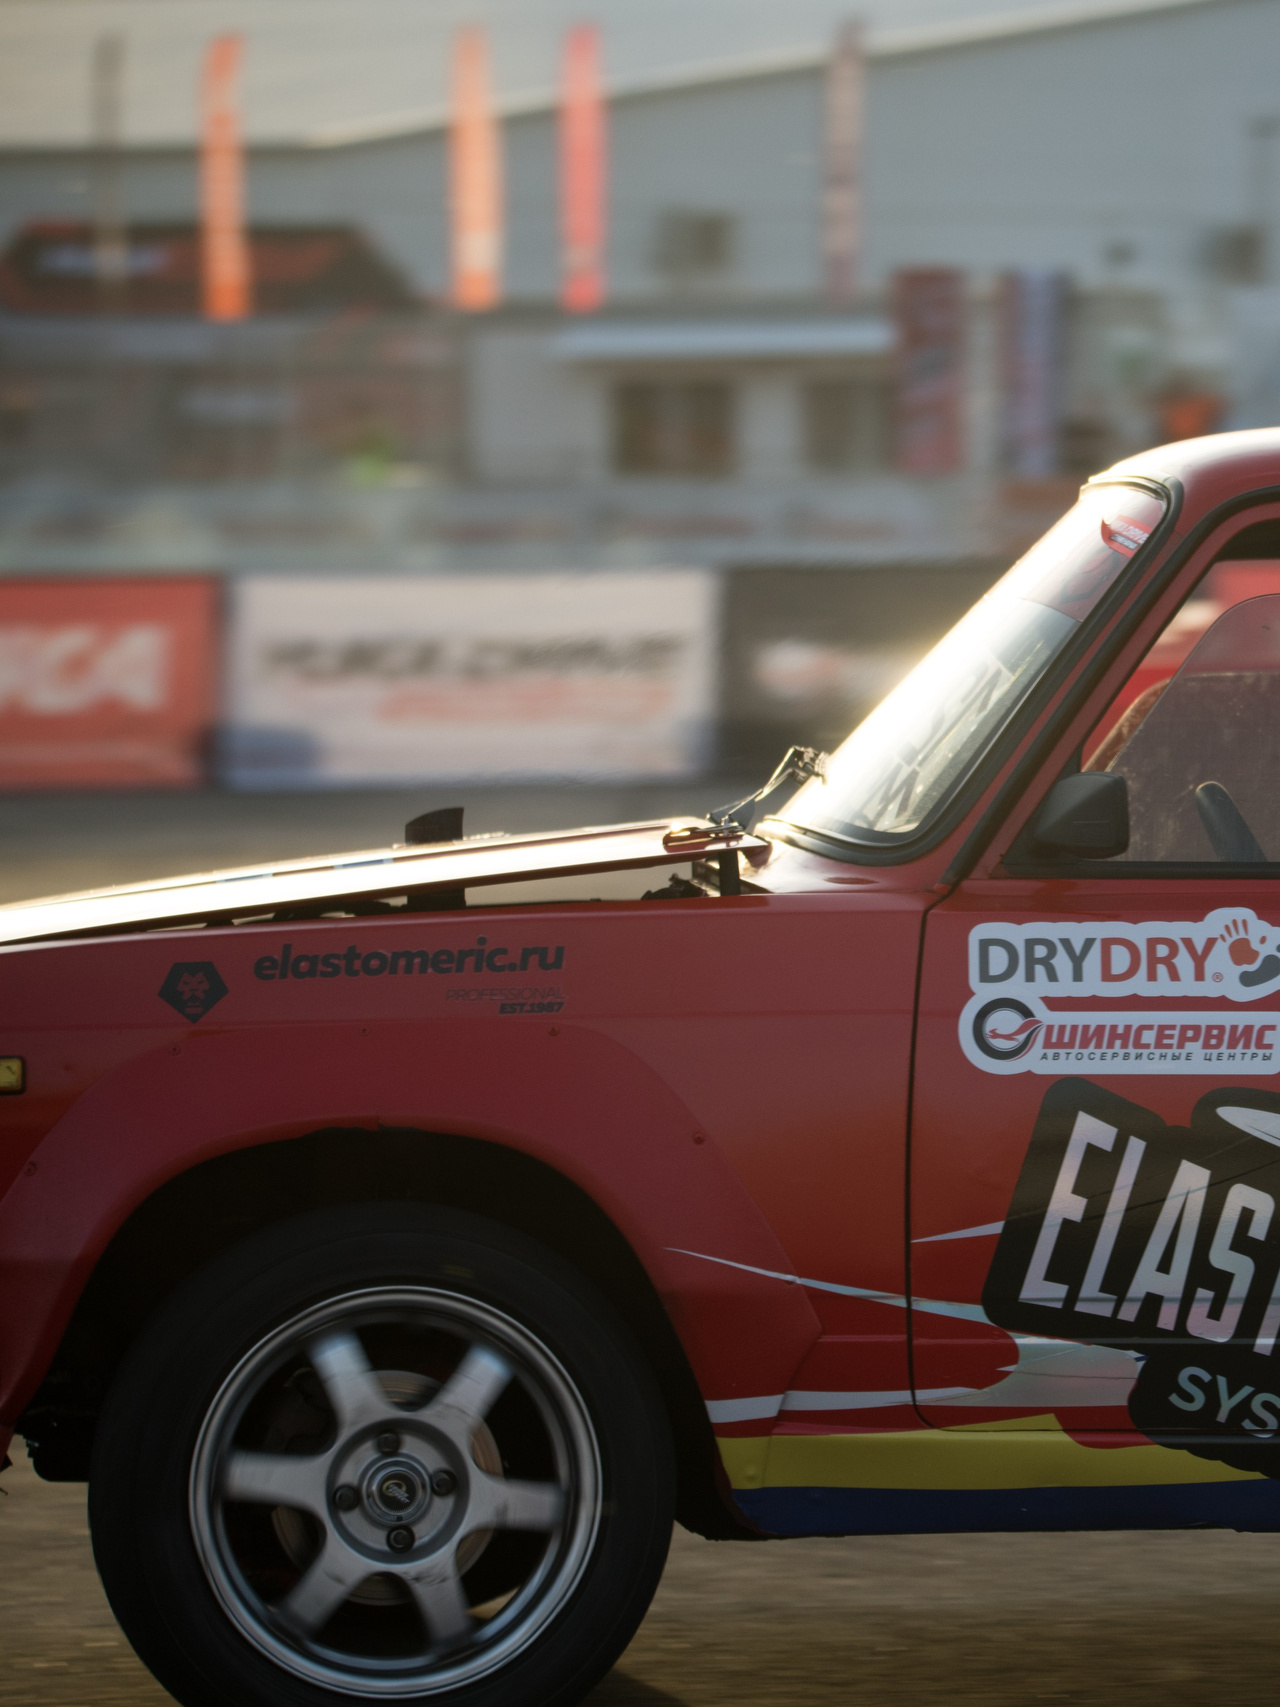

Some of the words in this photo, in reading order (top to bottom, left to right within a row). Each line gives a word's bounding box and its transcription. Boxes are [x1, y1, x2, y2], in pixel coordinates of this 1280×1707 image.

[252, 936, 566, 981] elastomeric.ru
[445, 986, 566, 1002] PROFESSIONAL
[499, 1002, 565, 1015] EST.1987
[1041, 1023, 1278, 1051] ШИНСЕРВИС
[1040, 1051, 1194, 1062] АВТОСЕРВИСНЫЕ
[1203, 1051, 1274, 1063] ЦЕНТРЫ
